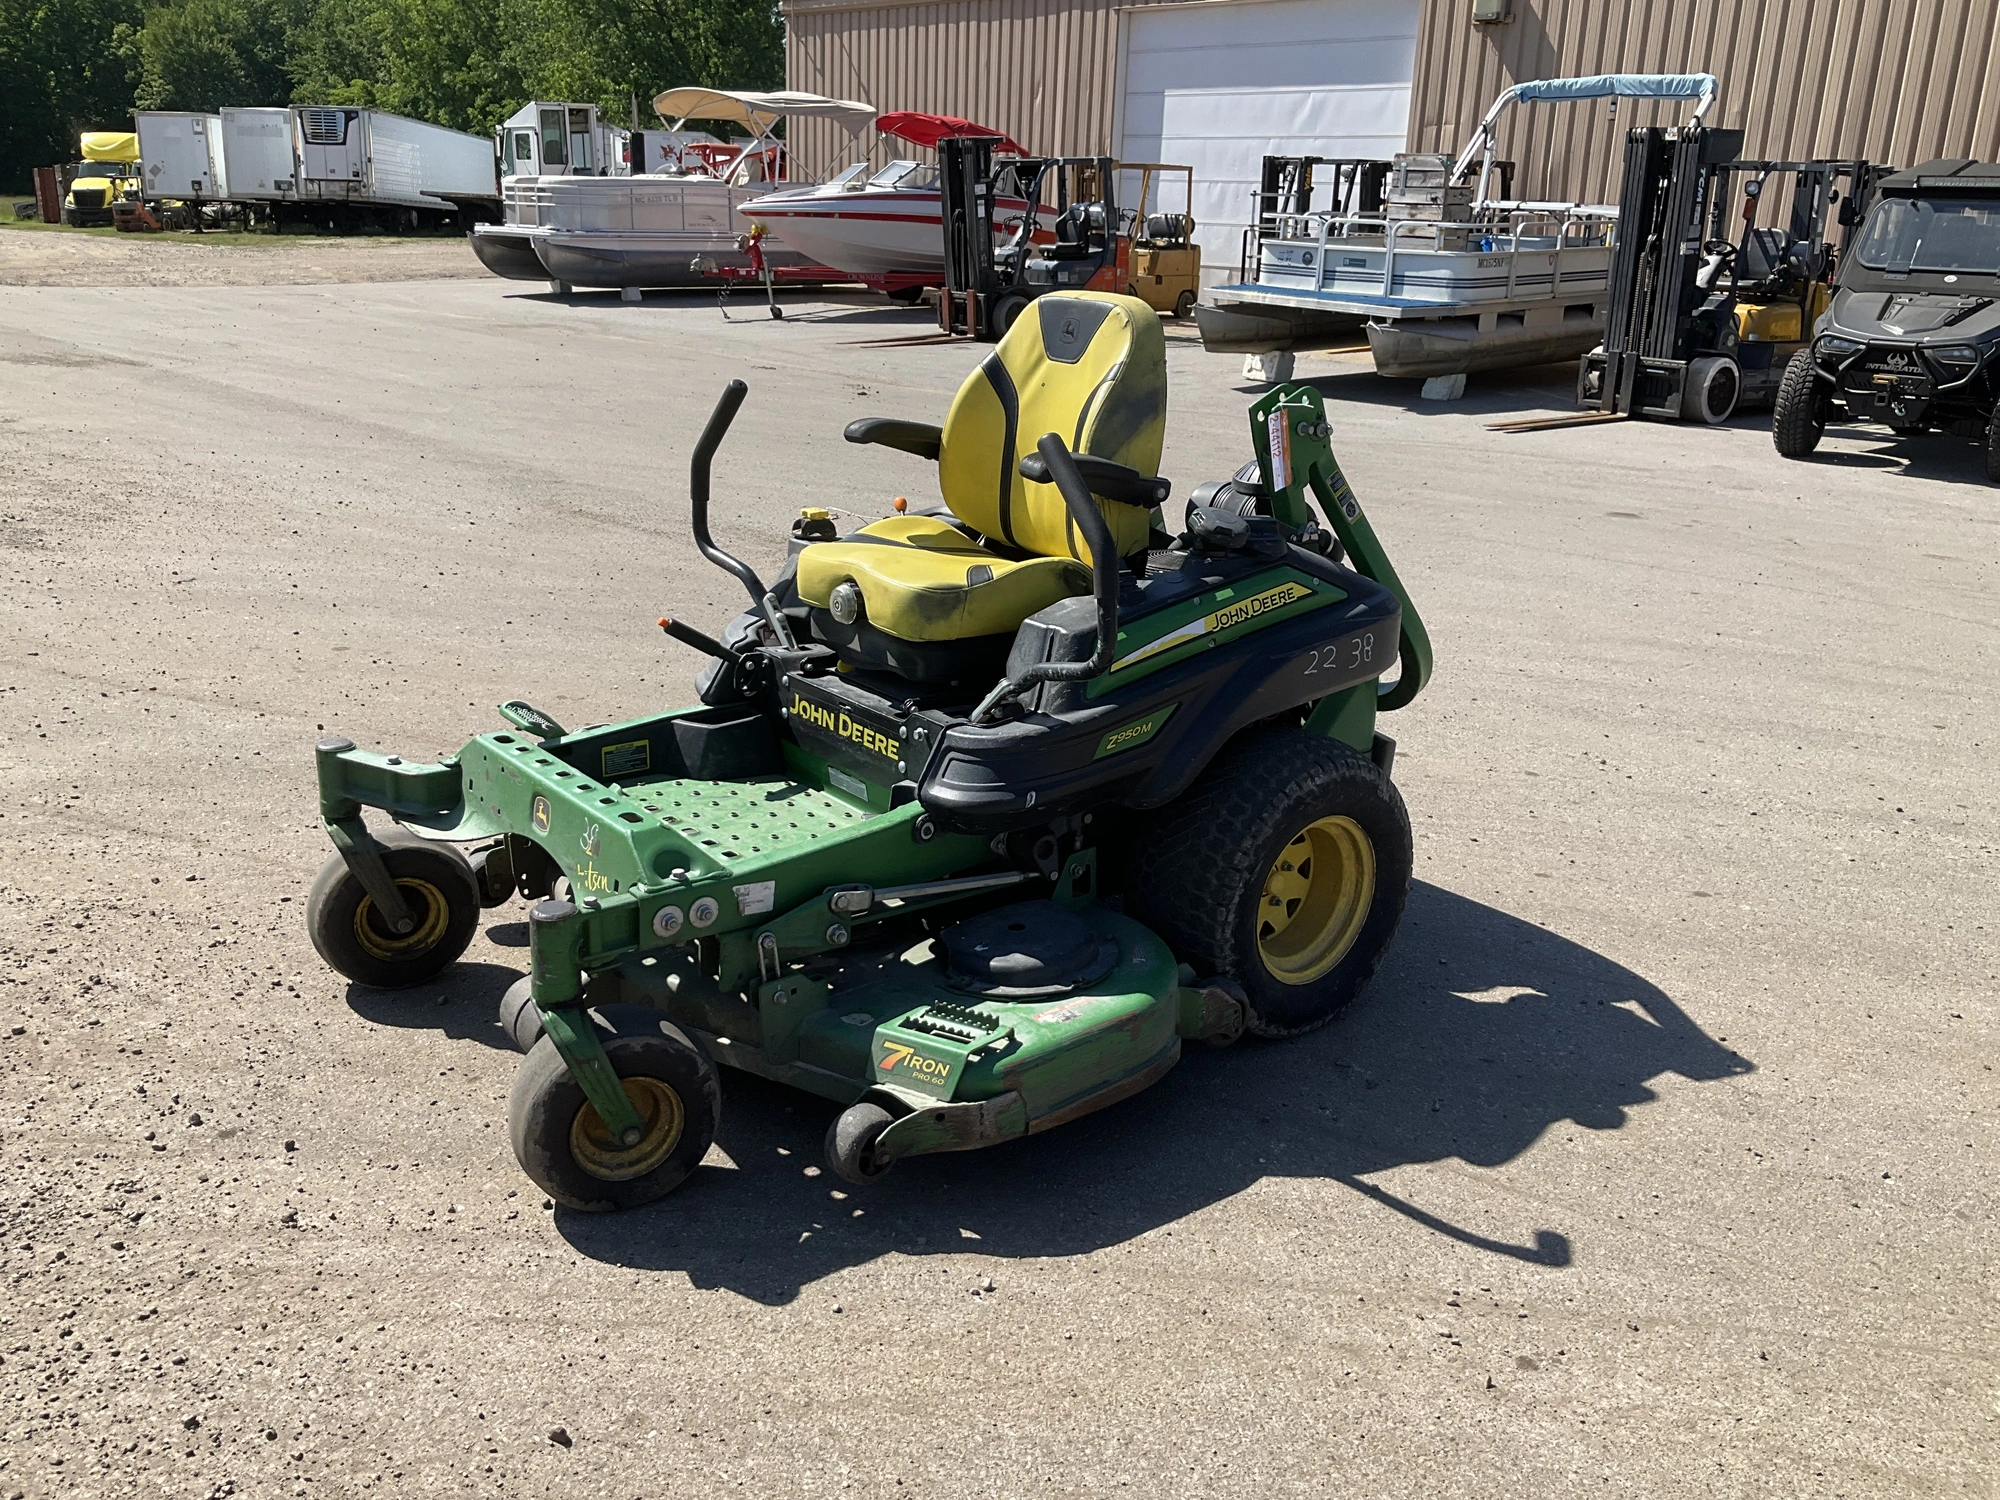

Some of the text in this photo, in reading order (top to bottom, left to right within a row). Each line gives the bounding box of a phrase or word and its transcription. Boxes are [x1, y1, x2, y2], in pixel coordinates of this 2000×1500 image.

[1304, 167, 1312, 191] Yale
[1696, 167, 1706, 202] TCM
[1269, 415, 1282, 459] 2-44112
[1212, 587, 1296, 630] JOHN DEERE
[1303, 632, 1374, 675] 22 38
[789, 693, 900, 761] JOHN DEERE
[1106, 721, 1153, 750] Z950M
[912, 1071, 945, 1085] PRO 60
